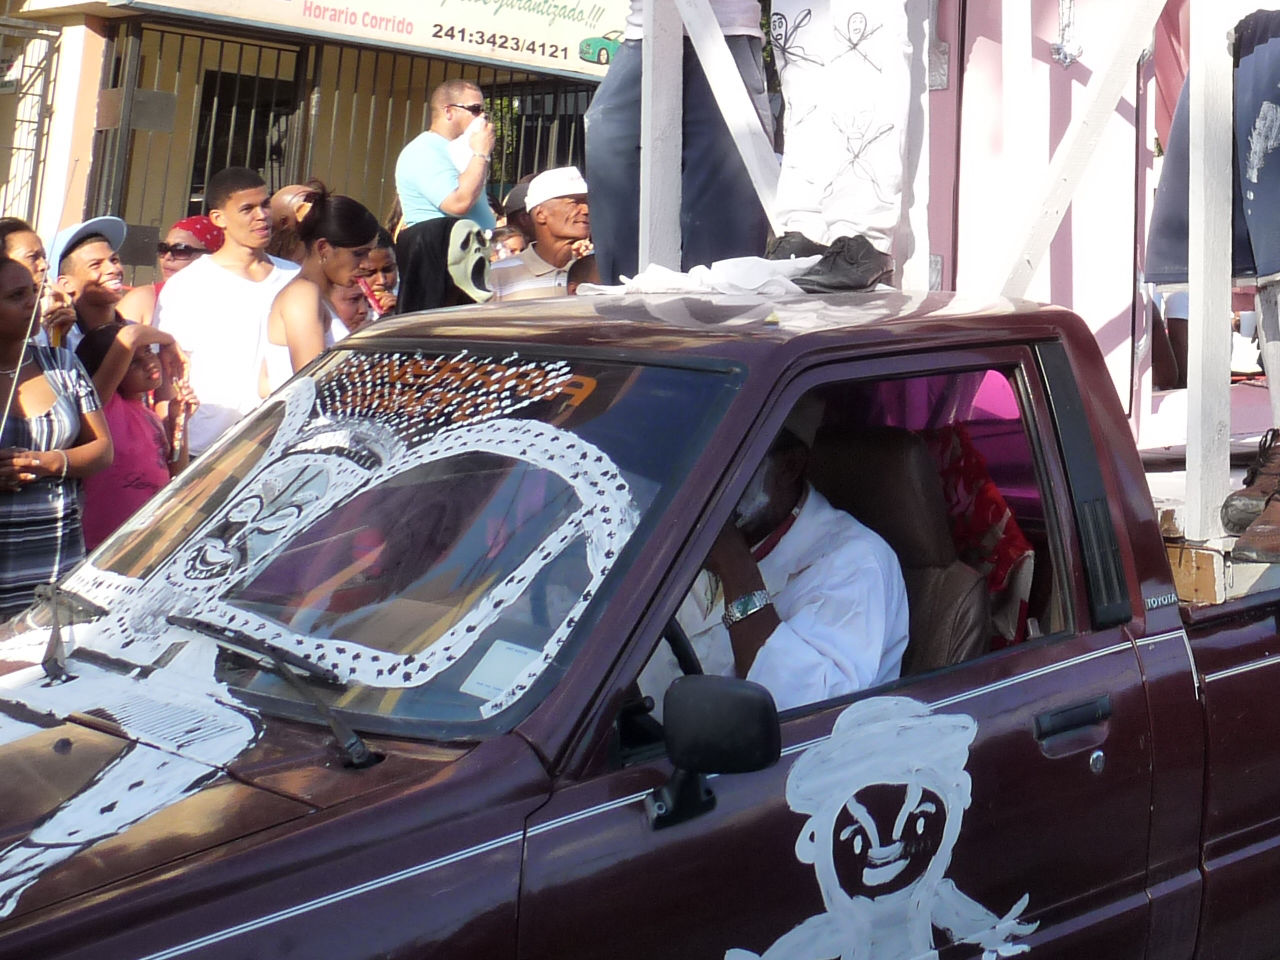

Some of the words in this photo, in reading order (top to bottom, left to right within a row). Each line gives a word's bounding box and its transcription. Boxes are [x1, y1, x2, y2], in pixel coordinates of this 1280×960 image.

[302, 0, 358, 26] Horario
[361, 10, 414, 36] Corrido
[431, 22, 570, 61] 241:3423/4121
[1146, 593, 1179, 609] TOYOTA
